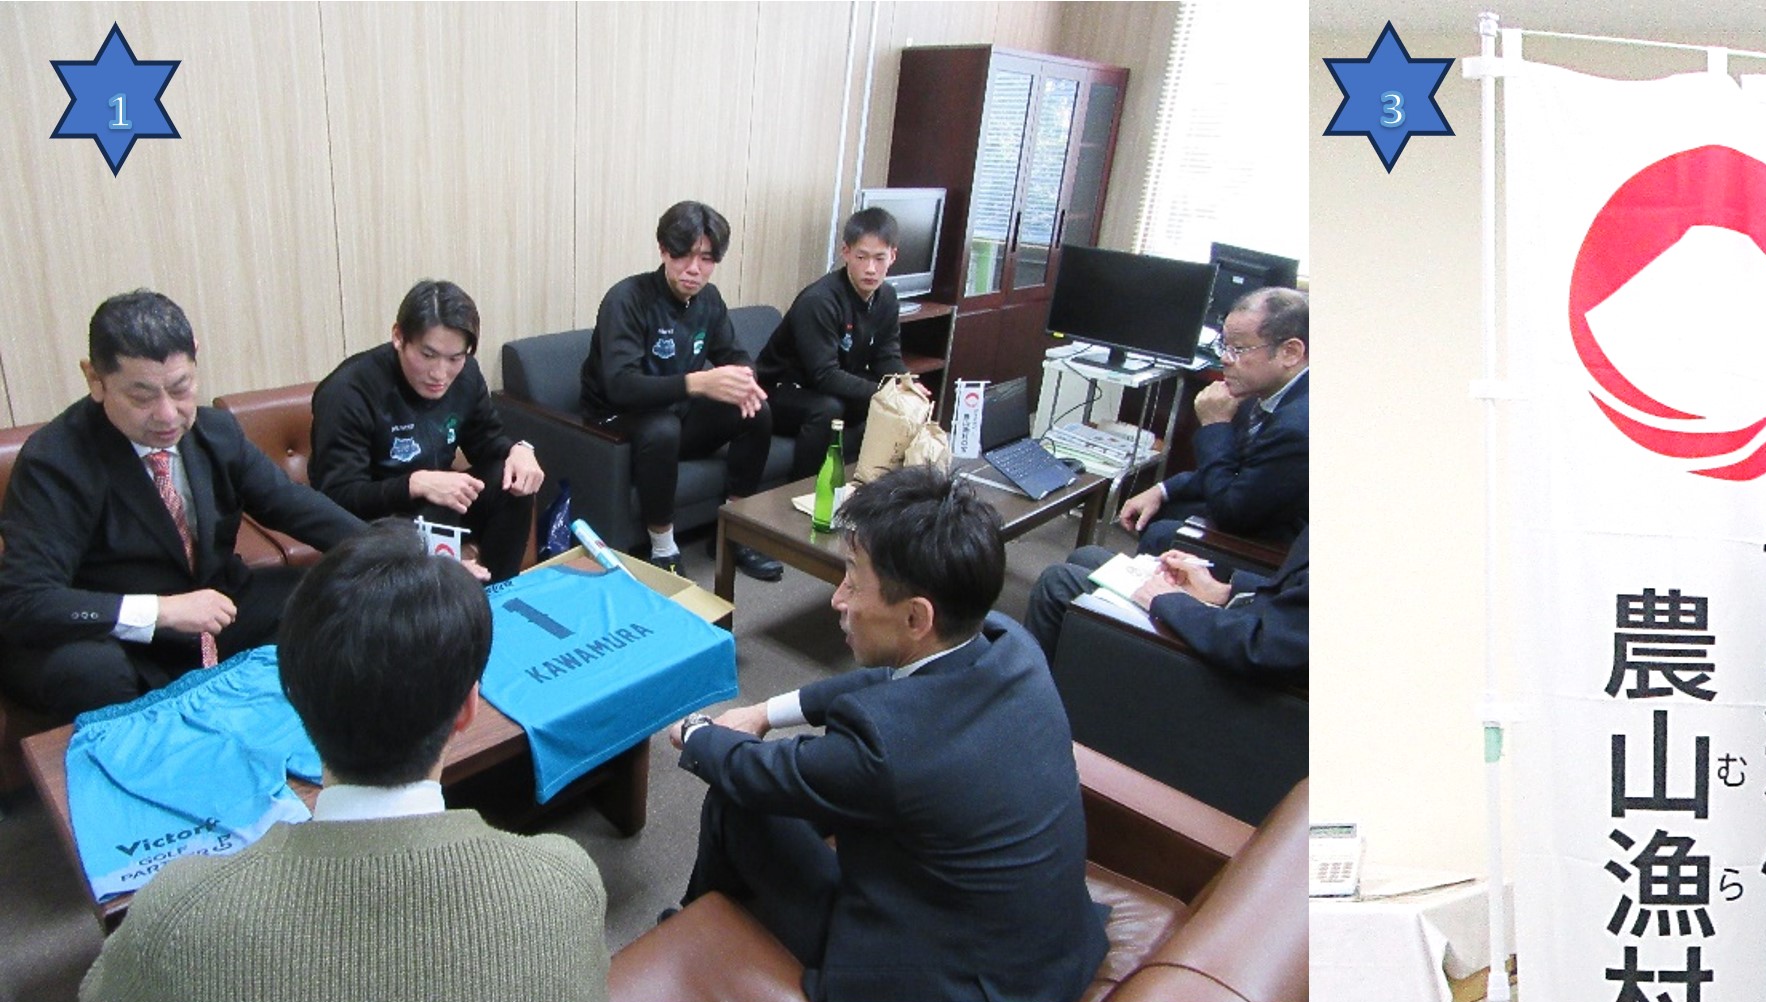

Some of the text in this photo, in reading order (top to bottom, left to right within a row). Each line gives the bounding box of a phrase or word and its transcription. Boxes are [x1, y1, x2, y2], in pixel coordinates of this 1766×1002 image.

[502, 597, 576, 640] 1
[524, 622, 655, 684] KAWAMURA
[1717, 752, 1749, 903] むら
